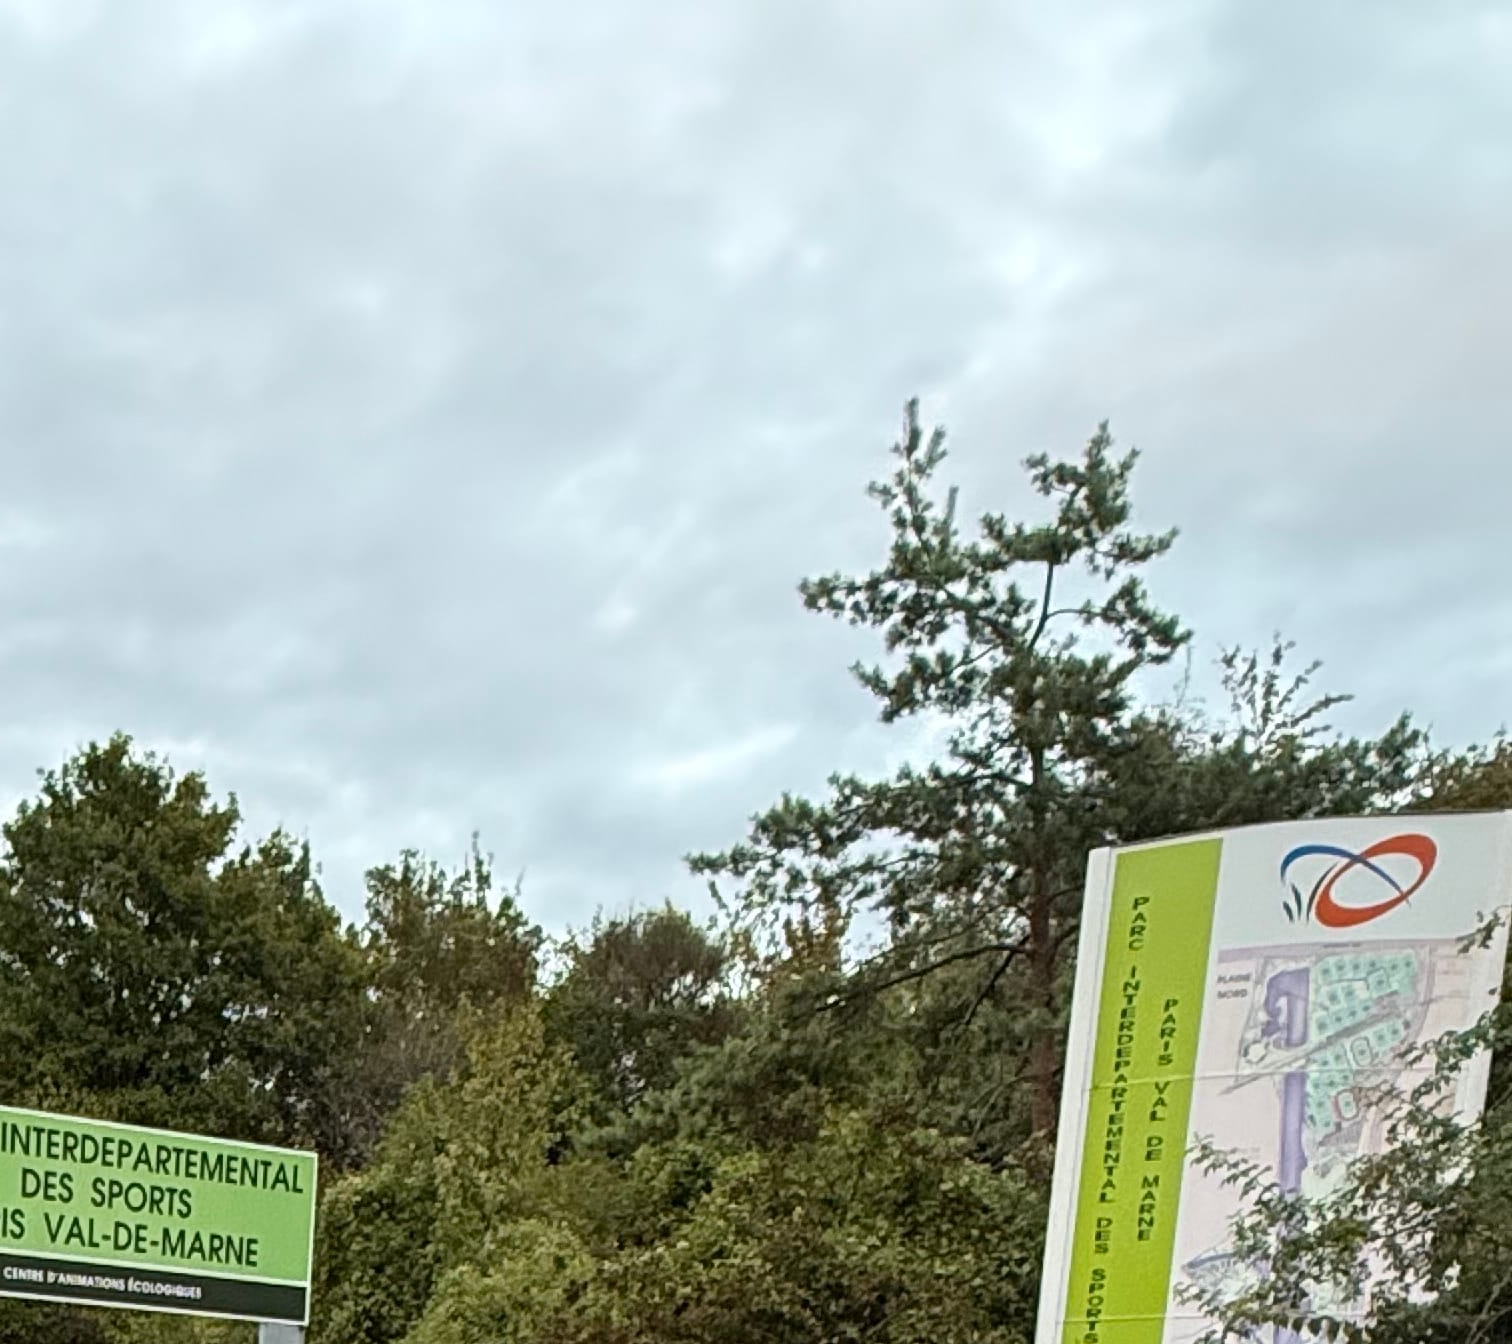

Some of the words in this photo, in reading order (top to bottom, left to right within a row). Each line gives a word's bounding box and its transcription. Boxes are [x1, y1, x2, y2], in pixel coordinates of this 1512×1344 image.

[1128, 896, 1150, 951] PARC
[1157, 998, 1179, 1067] PARIS
[1098, 965, 1141, 1204] INTERDEPARTEMENTAL
[1149, 1081, 1170, 1122] VAL
[1, 1121, 303, 1194] INTERDEPARTEMENTAL
[1144, 1135, 1164, 1171] DE
[21, 1167, 74, 1204] DES
[90, 1176, 192, 1219] SPORTS
[1136, 1175, 1160, 1242] MARNE
[43, 1212, 259, 1268] VAL-DE-MARNE
[1094, 1217, 1113, 1254] DES
[3, 1266, 43, 1283] CENTRE
[46, 1270, 125, 1291] D'ANIMATIONS
[127, 1276, 202, 1300] ÉCOLOGIQUES
[1083, 1268, 1106, 1344] SPORTS
